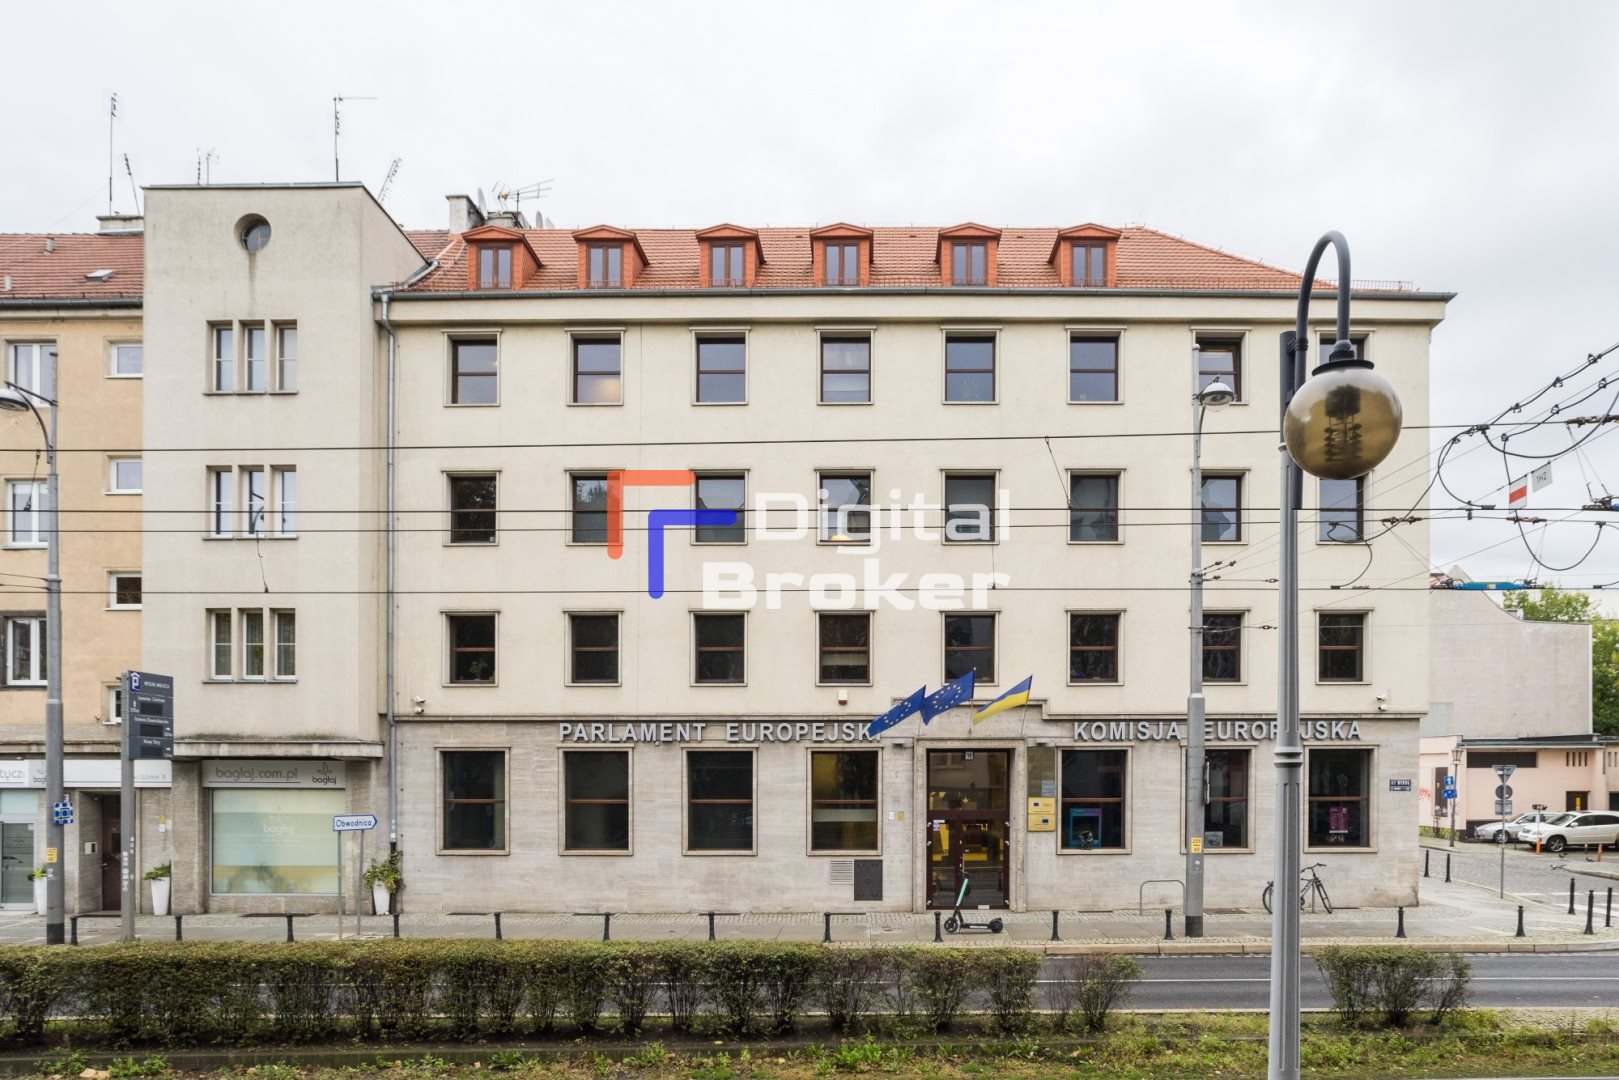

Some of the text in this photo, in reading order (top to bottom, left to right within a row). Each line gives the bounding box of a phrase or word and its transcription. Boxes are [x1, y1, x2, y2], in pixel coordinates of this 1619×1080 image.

[559, 722, 706, 742] PARLAMENT
[1073, 720, 1361, 741] KOMISJA EUROPJSKA
[335, 819, 372, 828] Obwodnica
